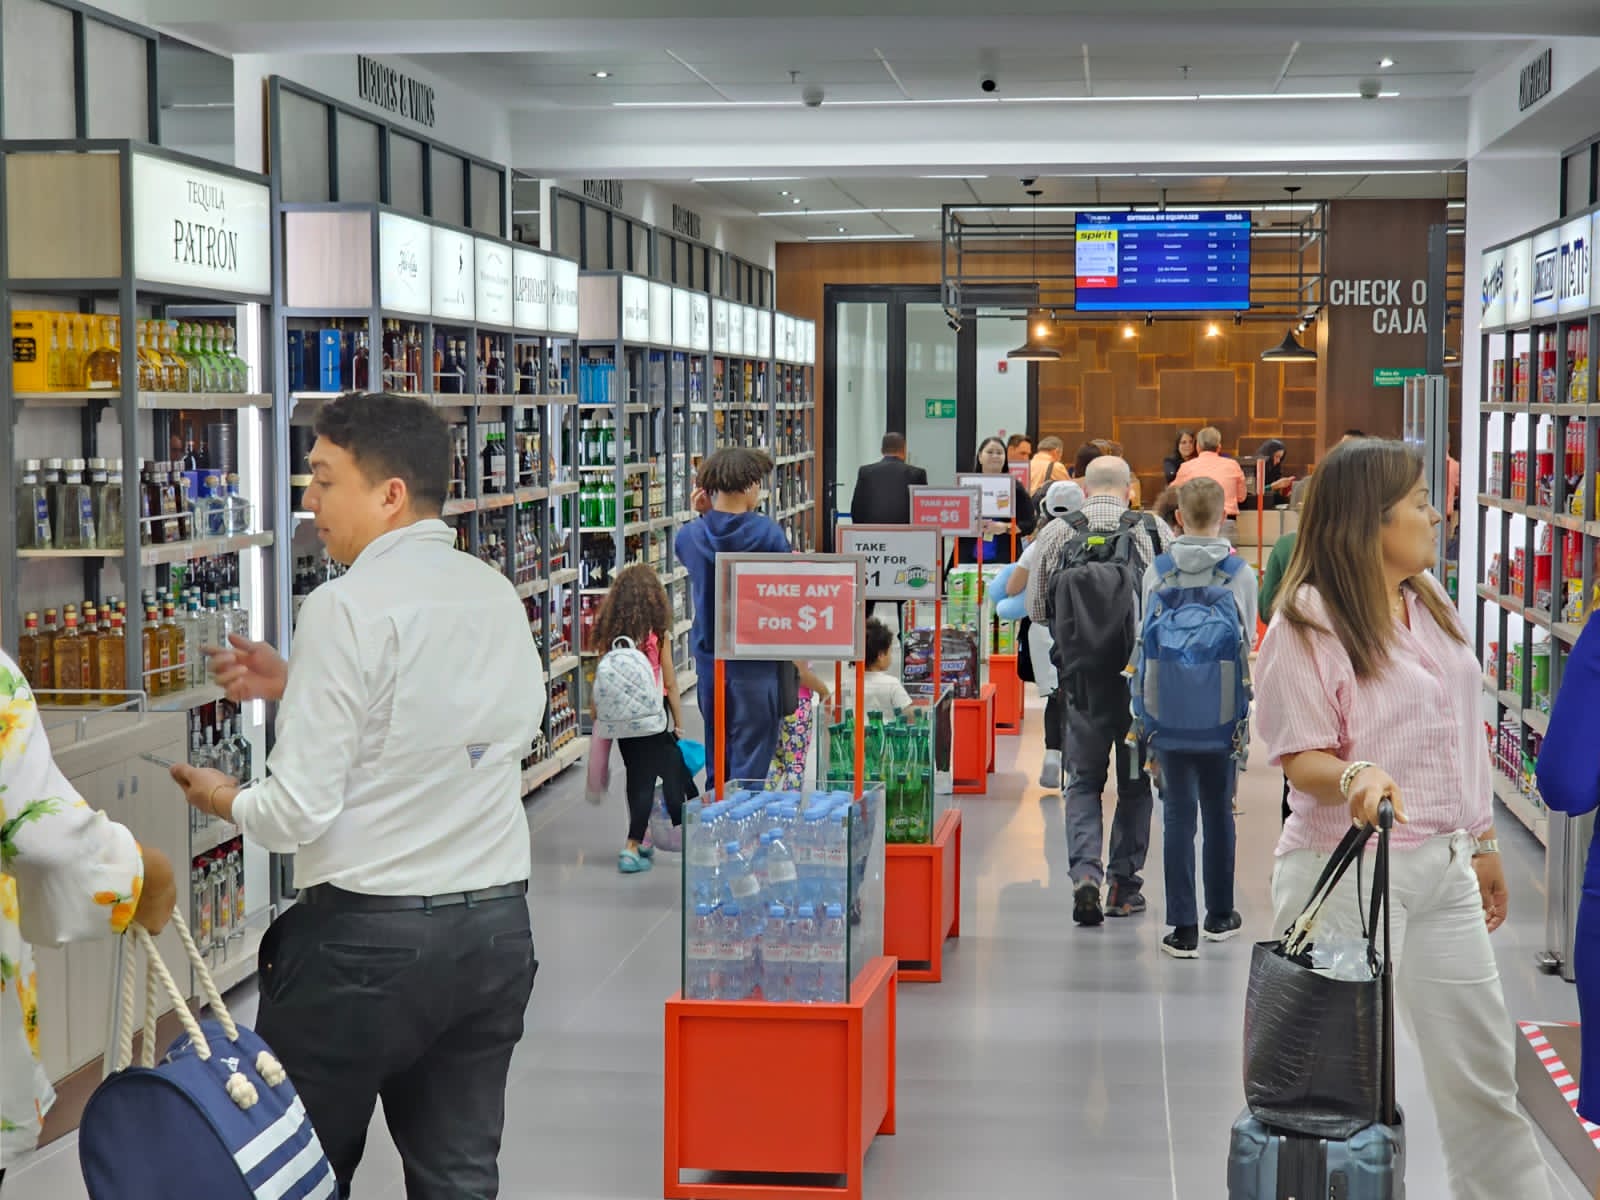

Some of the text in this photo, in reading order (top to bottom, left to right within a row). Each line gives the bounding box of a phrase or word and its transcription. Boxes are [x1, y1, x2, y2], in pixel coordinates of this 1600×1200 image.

[186, 180, 225, 212] TEQUILA
[174, 217, 238, 272] PATRÓN
[1080, 230, 1113, 241] spirit
[1330, 280, 1401, 306] CHECK
[1373, 308, 1427, 334] CAJA
[856, 543, 886, 552] TAKE
[884, 556, 907, 564] FOR
[757, 583, 841, 597] TAKE ANY
[758, 604, 834, 632] FOR $1
